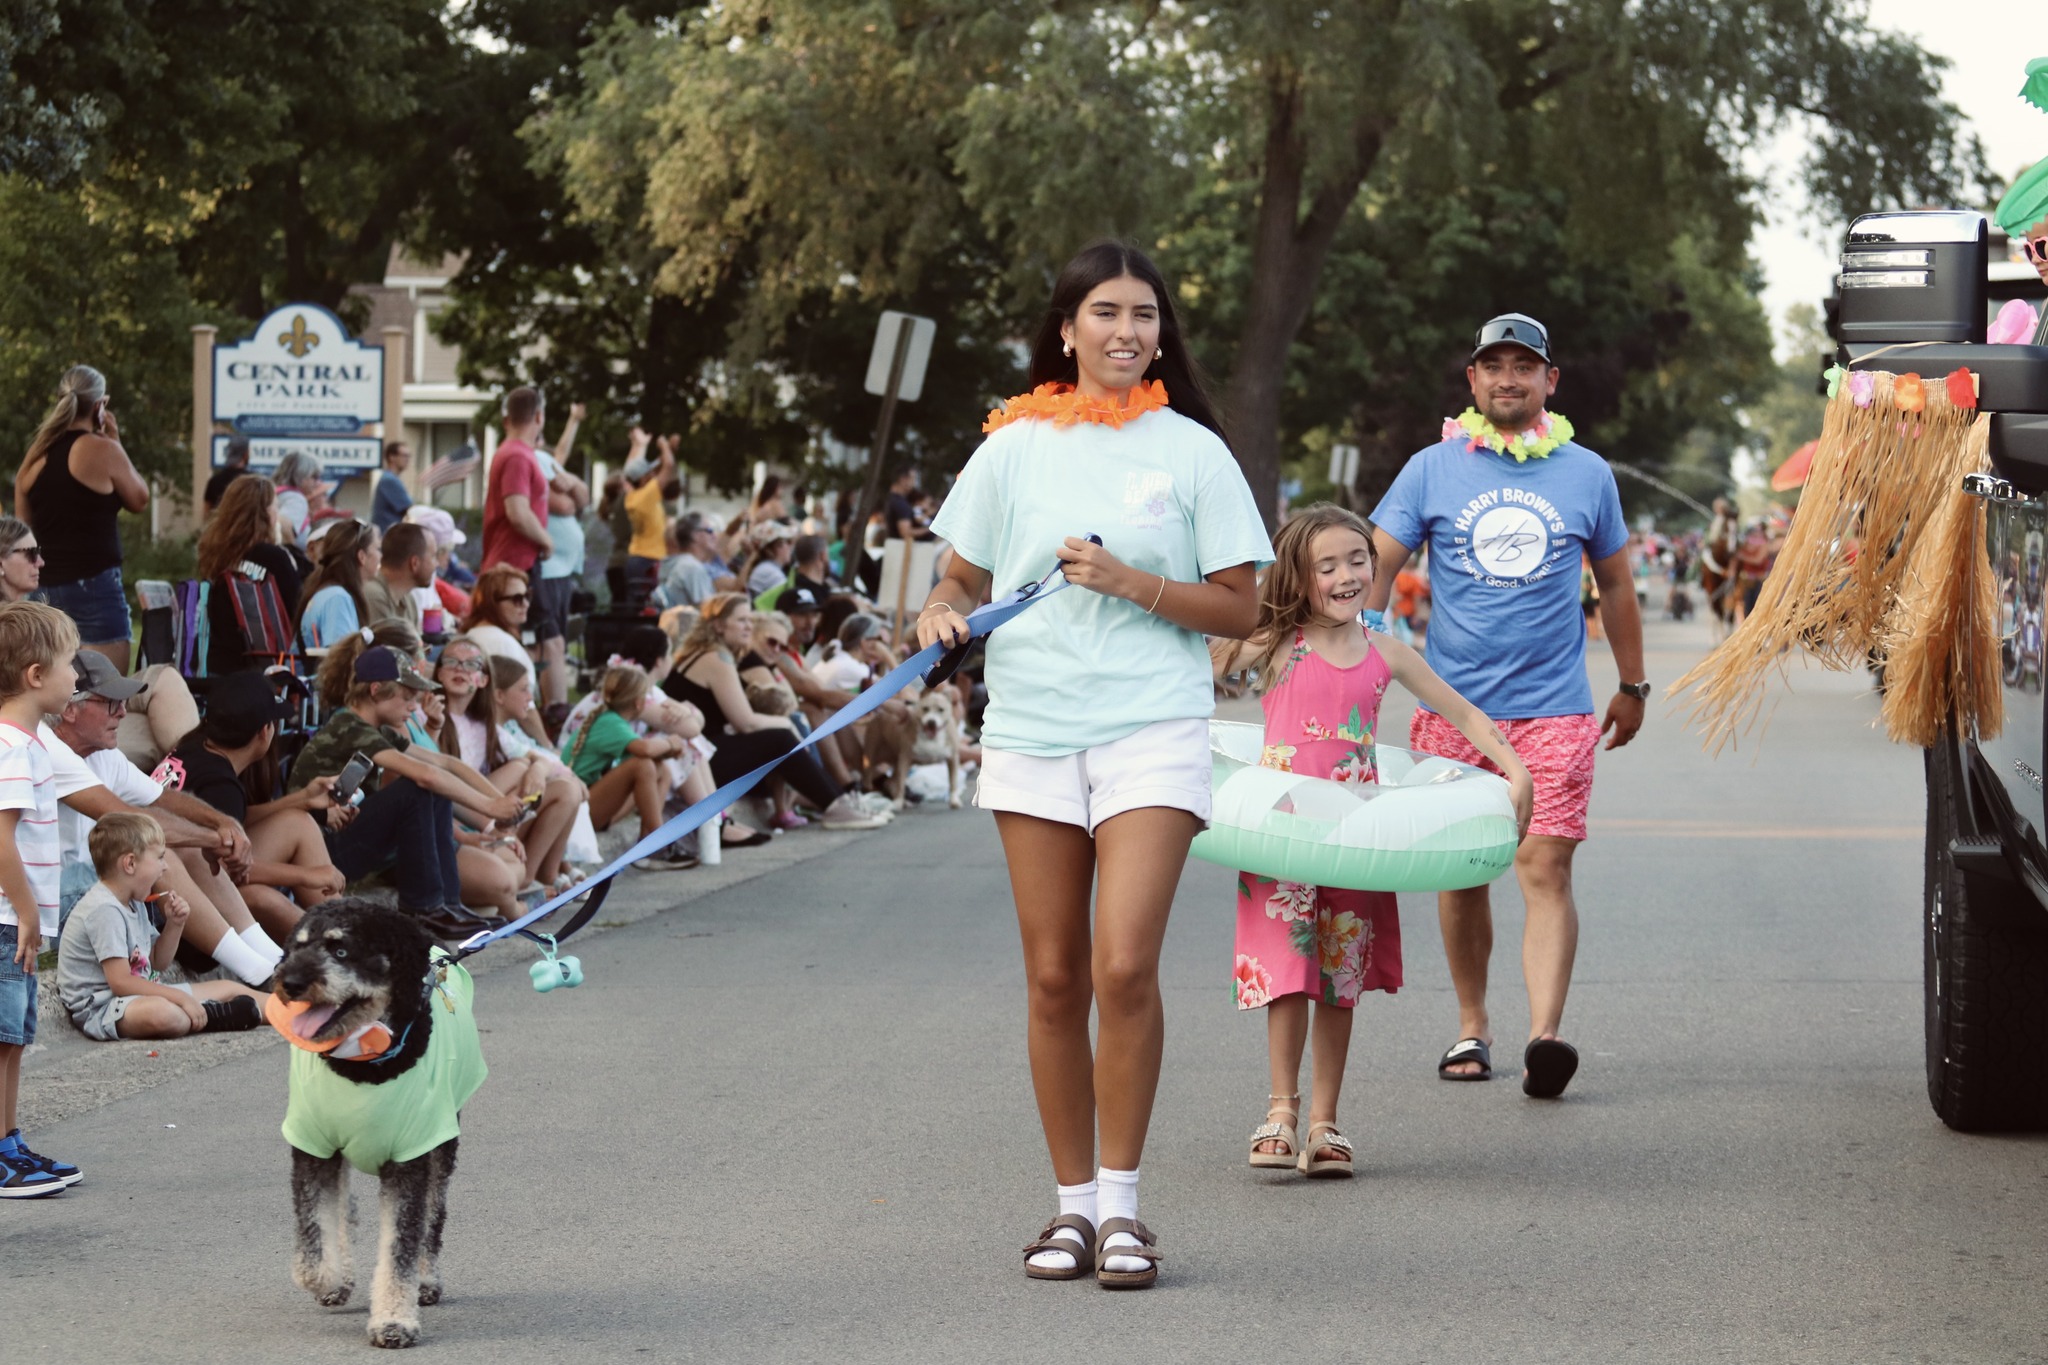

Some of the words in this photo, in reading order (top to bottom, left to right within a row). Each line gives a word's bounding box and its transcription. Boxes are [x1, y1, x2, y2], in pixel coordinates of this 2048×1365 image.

[227, 362, 371, 381] CENTRAL
[255, 384, 341, 397] PARK
[1454, 489, 1499, 532] HARRY
[1502, 487, 1566, 533] BROWN'S
[1485, 575, 1521, 588] Good.
